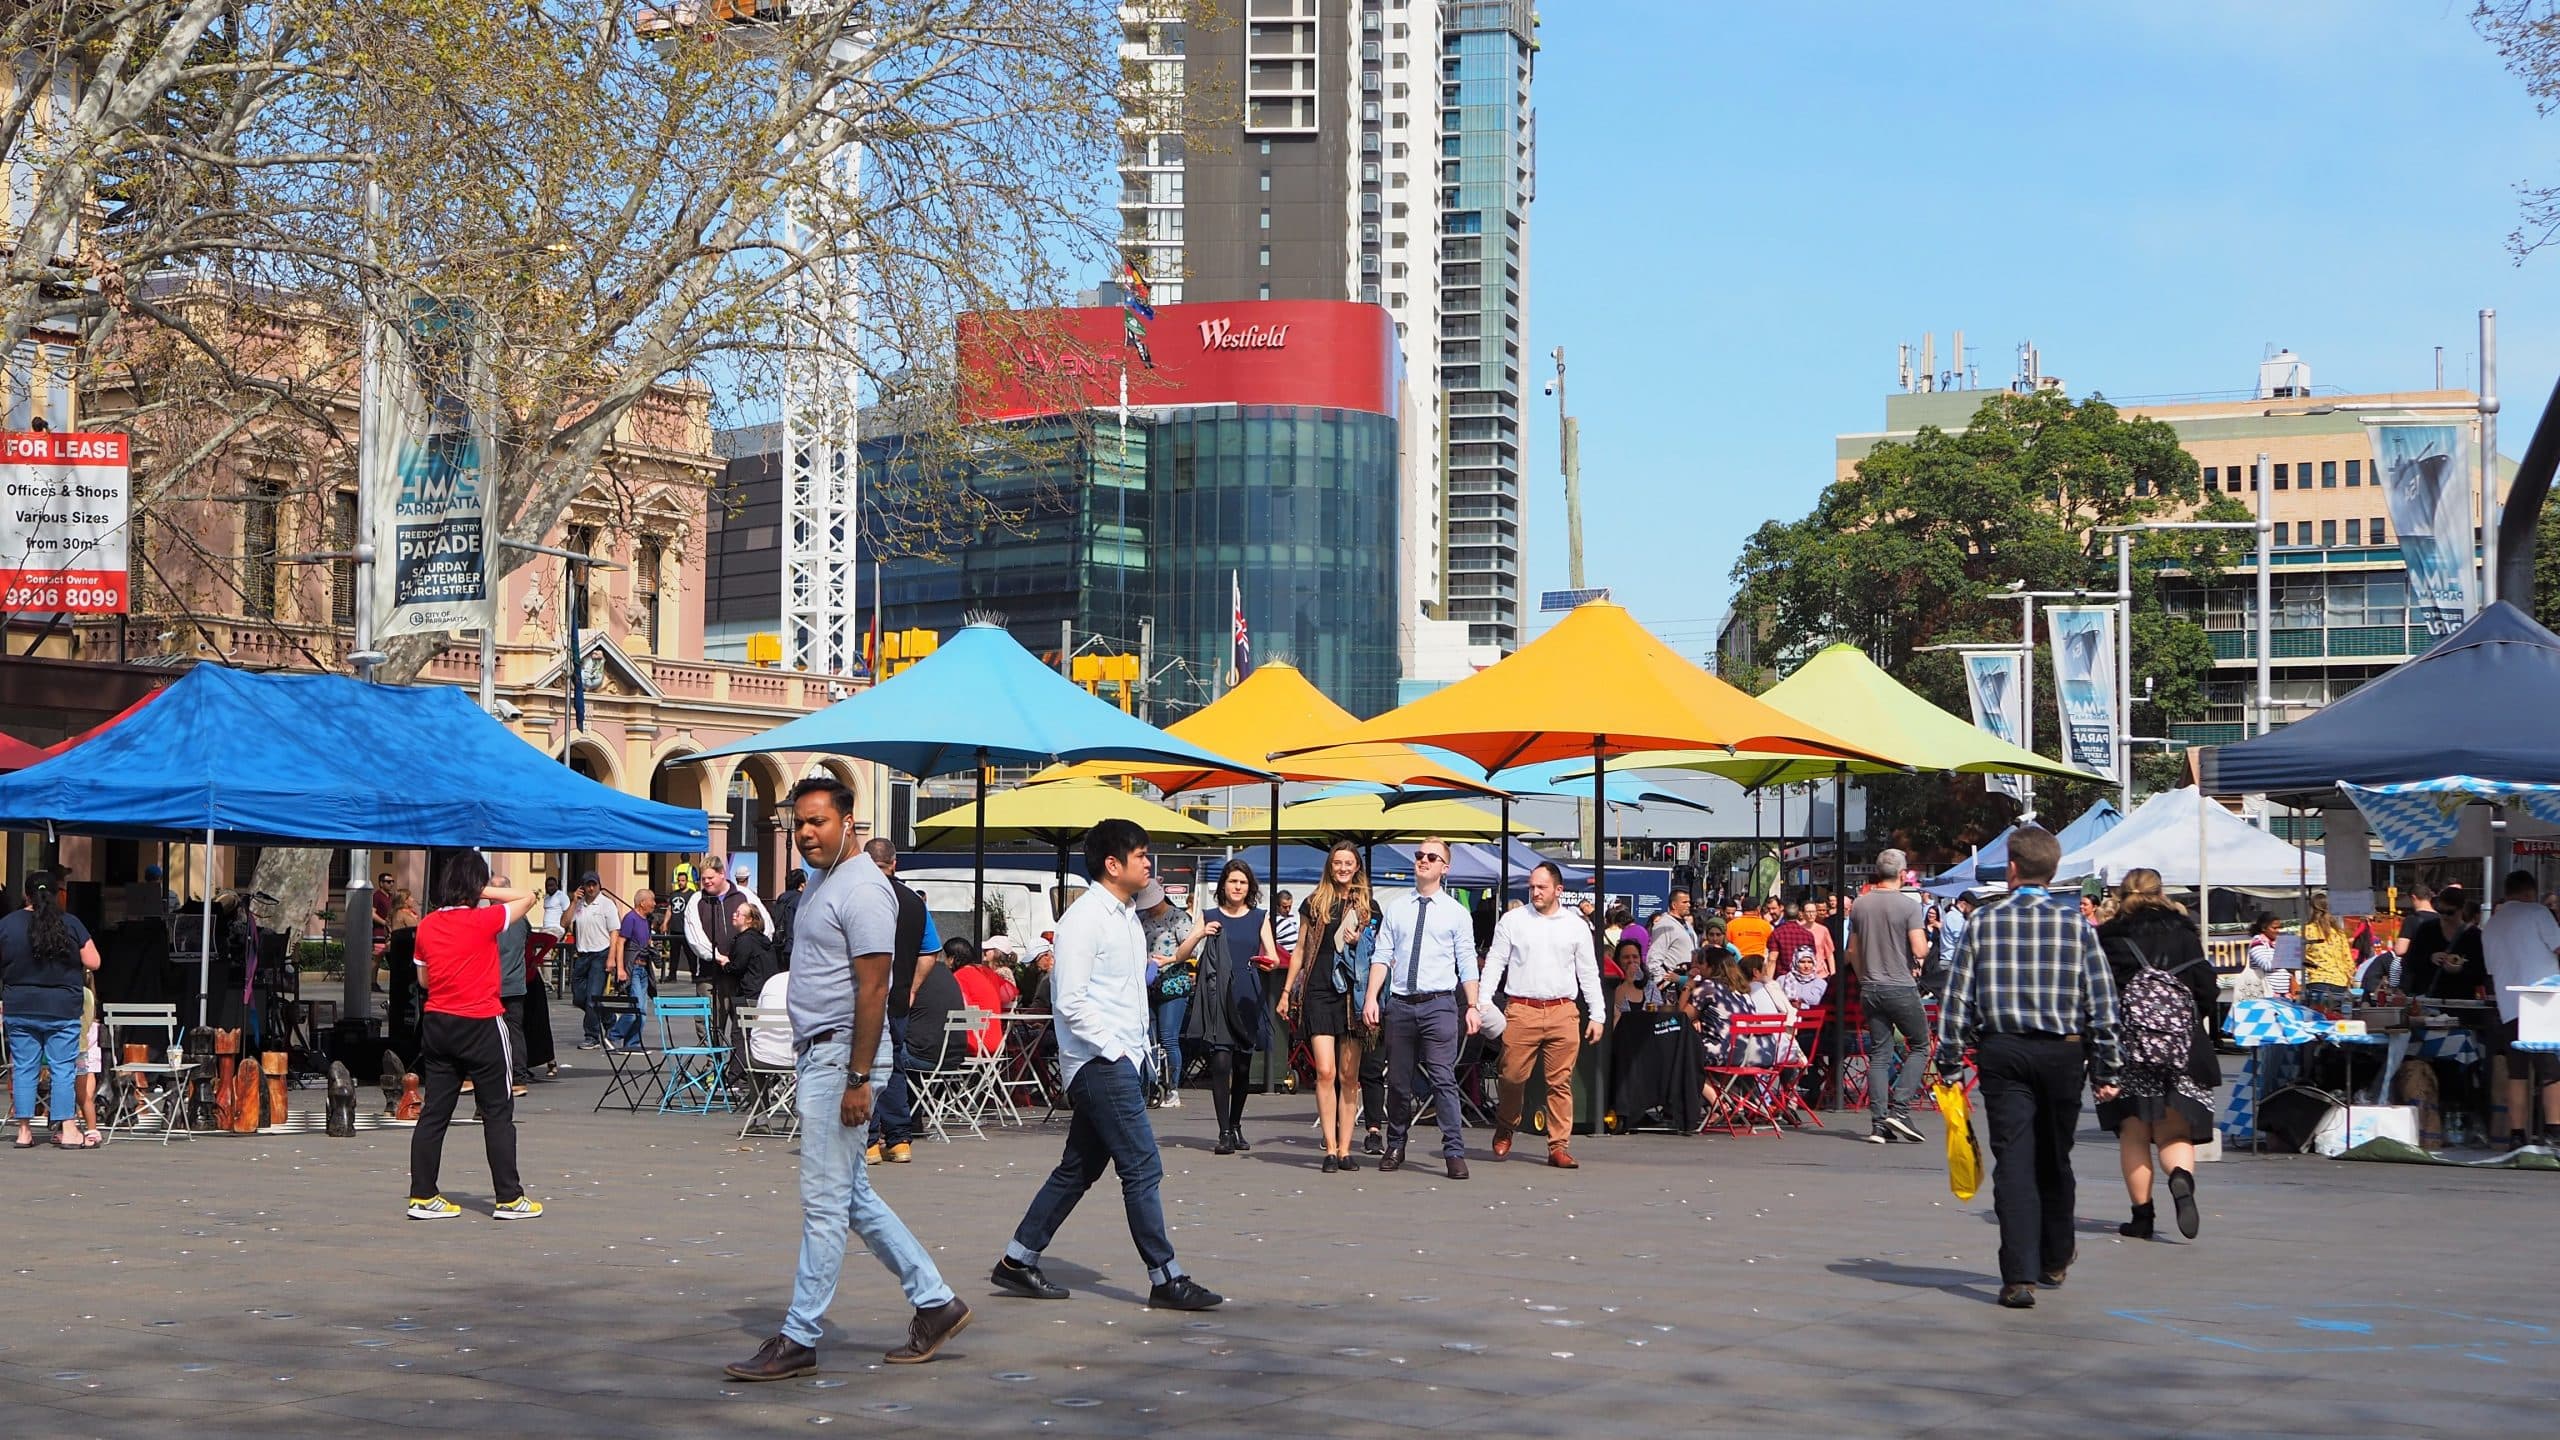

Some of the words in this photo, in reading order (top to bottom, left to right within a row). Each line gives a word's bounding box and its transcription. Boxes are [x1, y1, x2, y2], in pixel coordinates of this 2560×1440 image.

[1199, 317, 1289, 349] Westfield
[7, 439, 48, 458] FOR
[54, 440, 119, 459] LEASE
[7, 484, 56, 497] Offices
[61, 485, 70, 497] &
[75, 485, 119, 500] Shops
[16, 510, 67, 523] Various
[72, 511, 109, 524] Sizes
[451, 523, 480, 533] ENTRY
[26, 537, 57, 549] from
[412, 560, 469, 578] SAURDAY
[26, 574, 64, 585] Contact
[67, 575, 99, 585] Owner
[414, 572, 480, 586] EPTEMBER
[443, 584, 480, 595] STREET
[5, 588, 58, 607] 9806
[65, 588, 118, 607] 8099
[425, 611, 438, 619] CITY
